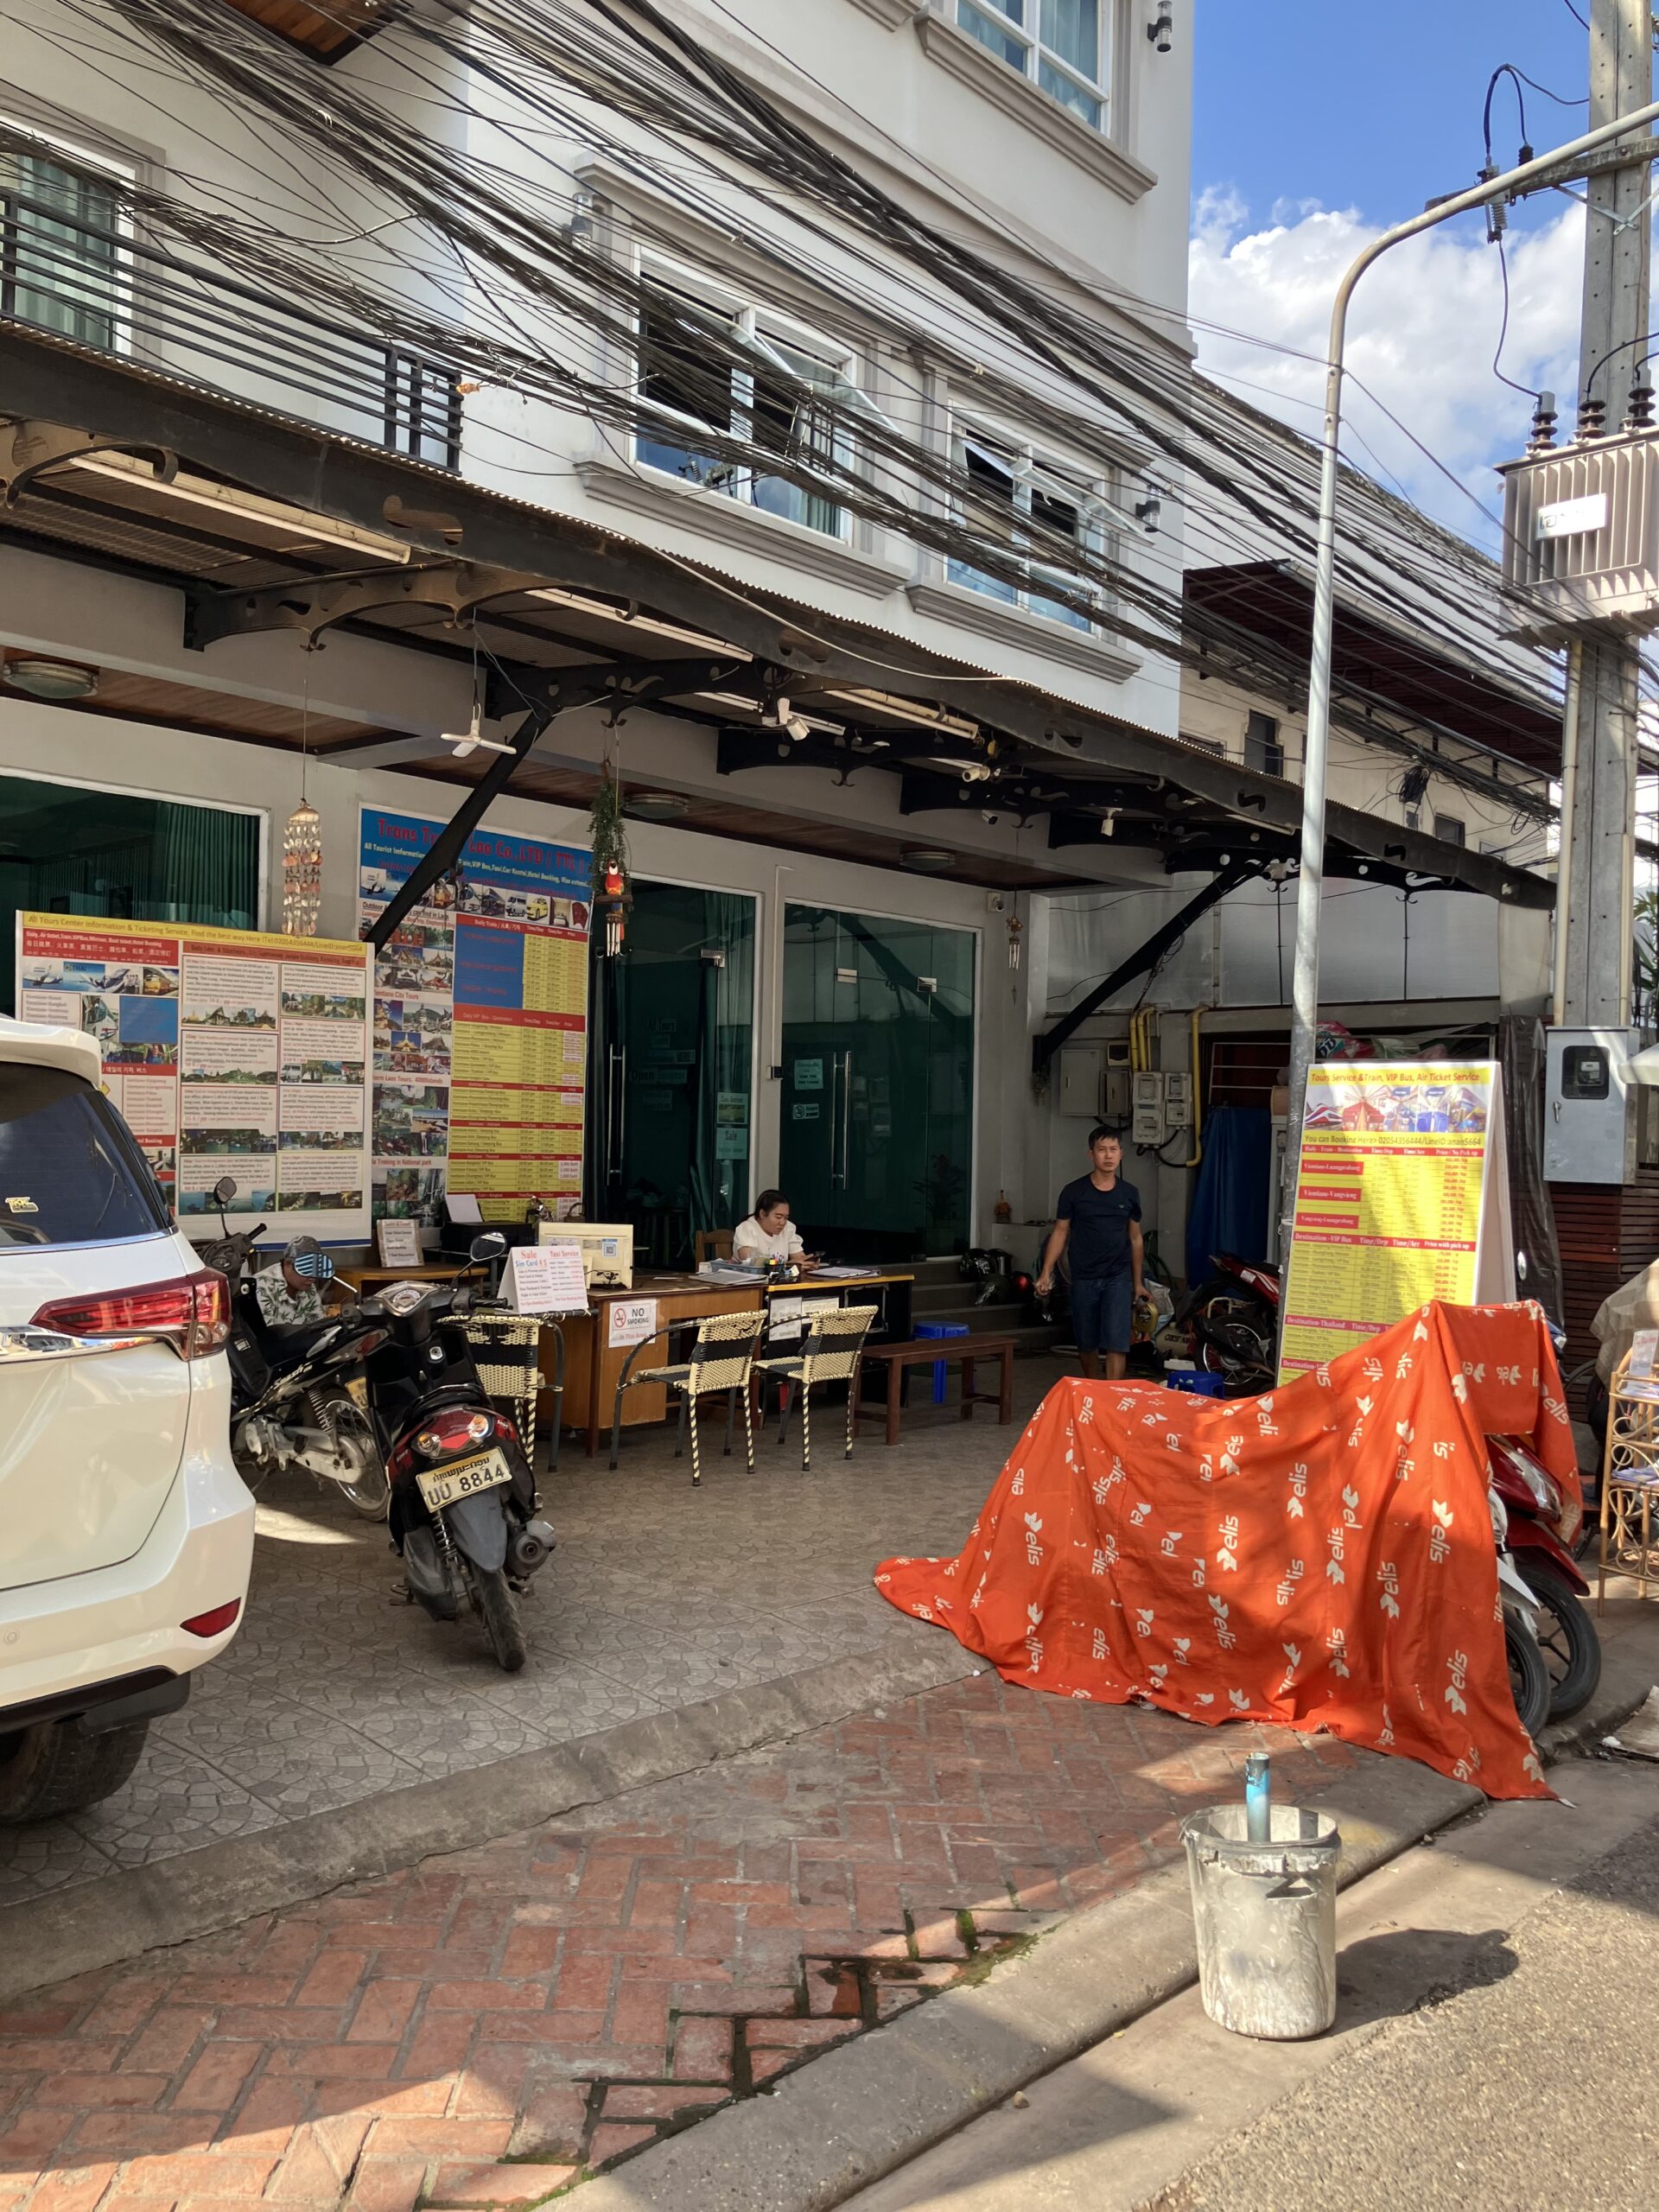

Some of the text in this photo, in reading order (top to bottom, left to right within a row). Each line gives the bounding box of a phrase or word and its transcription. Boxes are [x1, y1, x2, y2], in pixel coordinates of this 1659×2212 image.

[40, 918, 59, 926] Tours
[60, 918, 85, 927] Center
[135, 925, 164, 935] Ticketing
[1312, 1073, 1330, 1082] Tours
[1332, 1073, 1357, 1082] Service
[1416, 1073, 1429, 1082] Air
[1429, 1072, 1452, 1081] Ticket
[1452, 1072, 1480, 1081] Service
[520, 1249, 537, 1259] Sale
[1295, 1233, 1327, 1242] Destination
[1393, 1238, 1421, 1248] Time/Arr
[1450, 1242, 1461, 1250] pick
[627, 1317, 649, 1325] SMOKING
[632, 1307, 645, 1317] NO
[1078, 1395, 1095, 1424] elis
[1543, 1397, 1569, 1425] elis
[460, 1464, 504, 1492] 8844
[1395, 1445, 1415, 1481] elis
[1287, 1463, 1307, 1499] elis
[1219, 1514, 1239, 1551] elis
[1430, 1525, 1452, 1565] elis
[1025, 1530, 1044, 1567] elis
[1376, 1560, 1400, 1597] elis
[1092, 1627, 1111, 1660] elis
[1214, 1616, 1236, 1650] elis
[1446, 1649, 1467, 1690] elis
